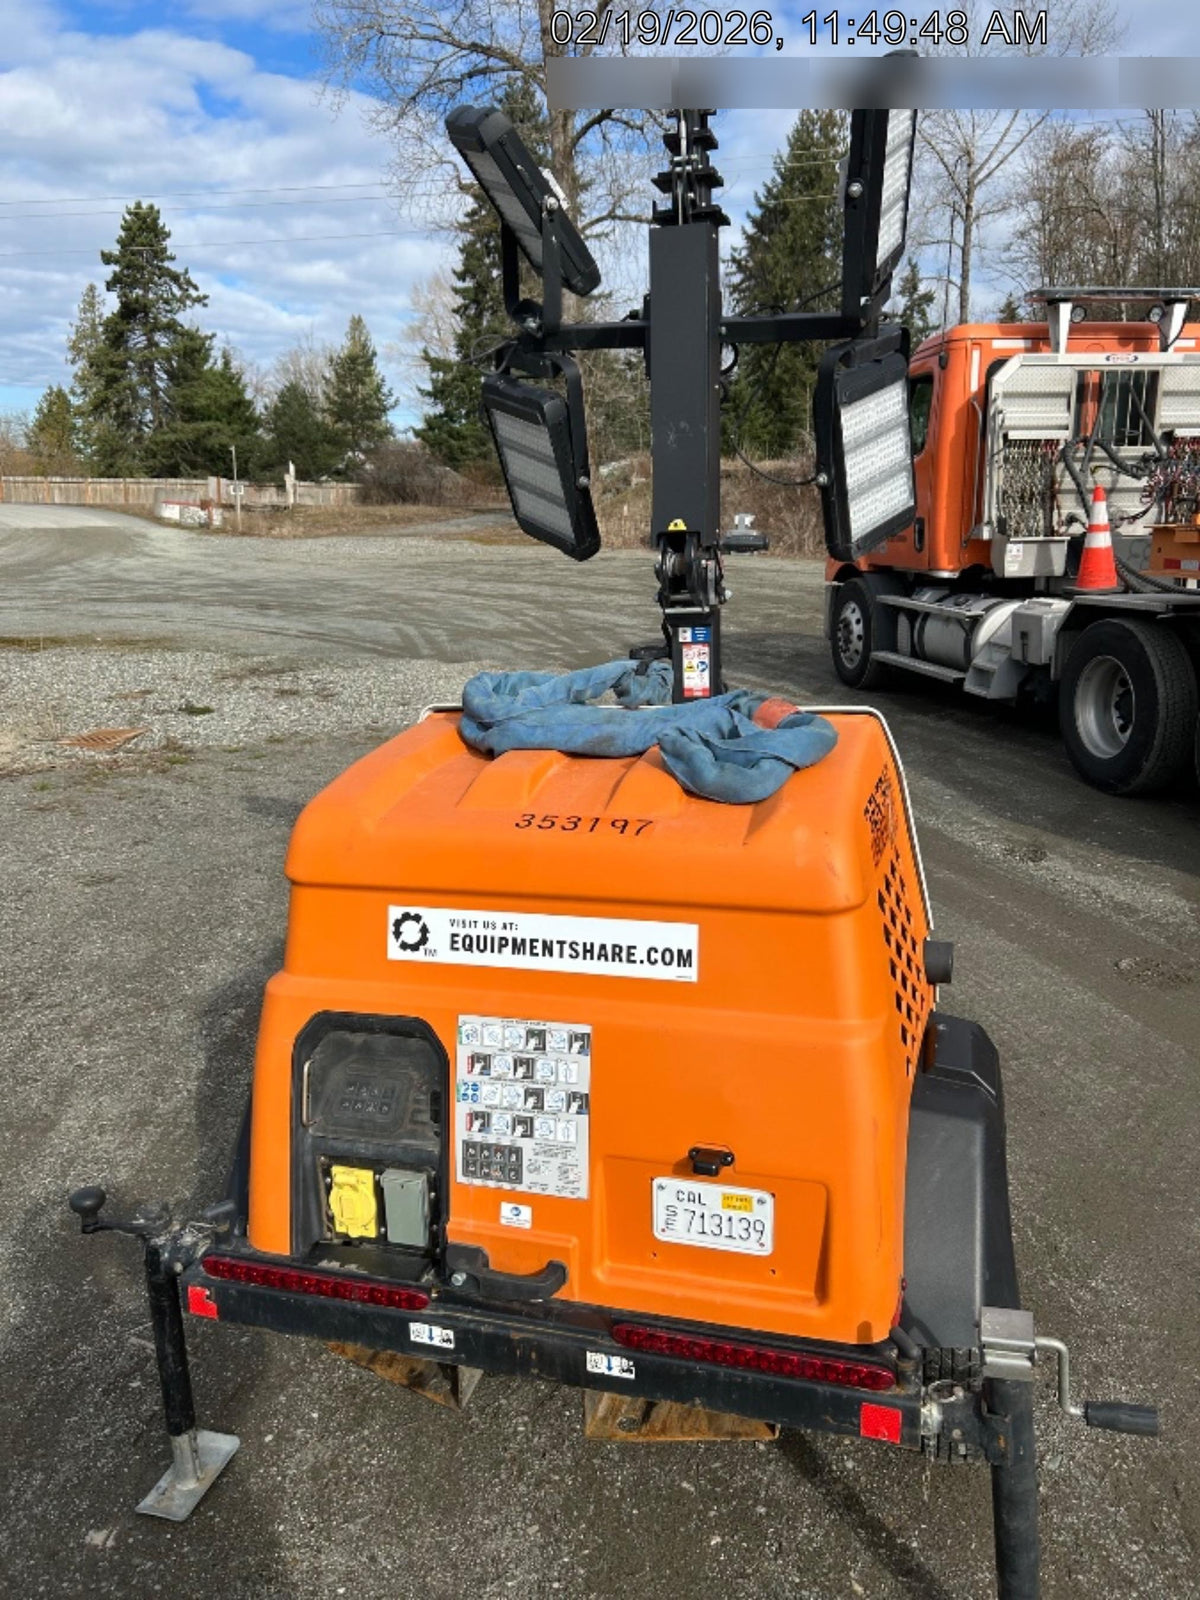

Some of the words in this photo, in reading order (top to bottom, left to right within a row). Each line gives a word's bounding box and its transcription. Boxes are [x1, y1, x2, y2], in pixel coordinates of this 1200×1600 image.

[514, 813, 654, 836] 353197
[449, 918, 479, 929] VISIT
[483, 920, 497, 931] US
[501, 921, 519, 932] AT:
[449, 932, 694, 969] EQUIPMENTSHARE.COM
[676, 1189, 708, 1207] CAL
[683, 1207, 767, 1244] 713139
